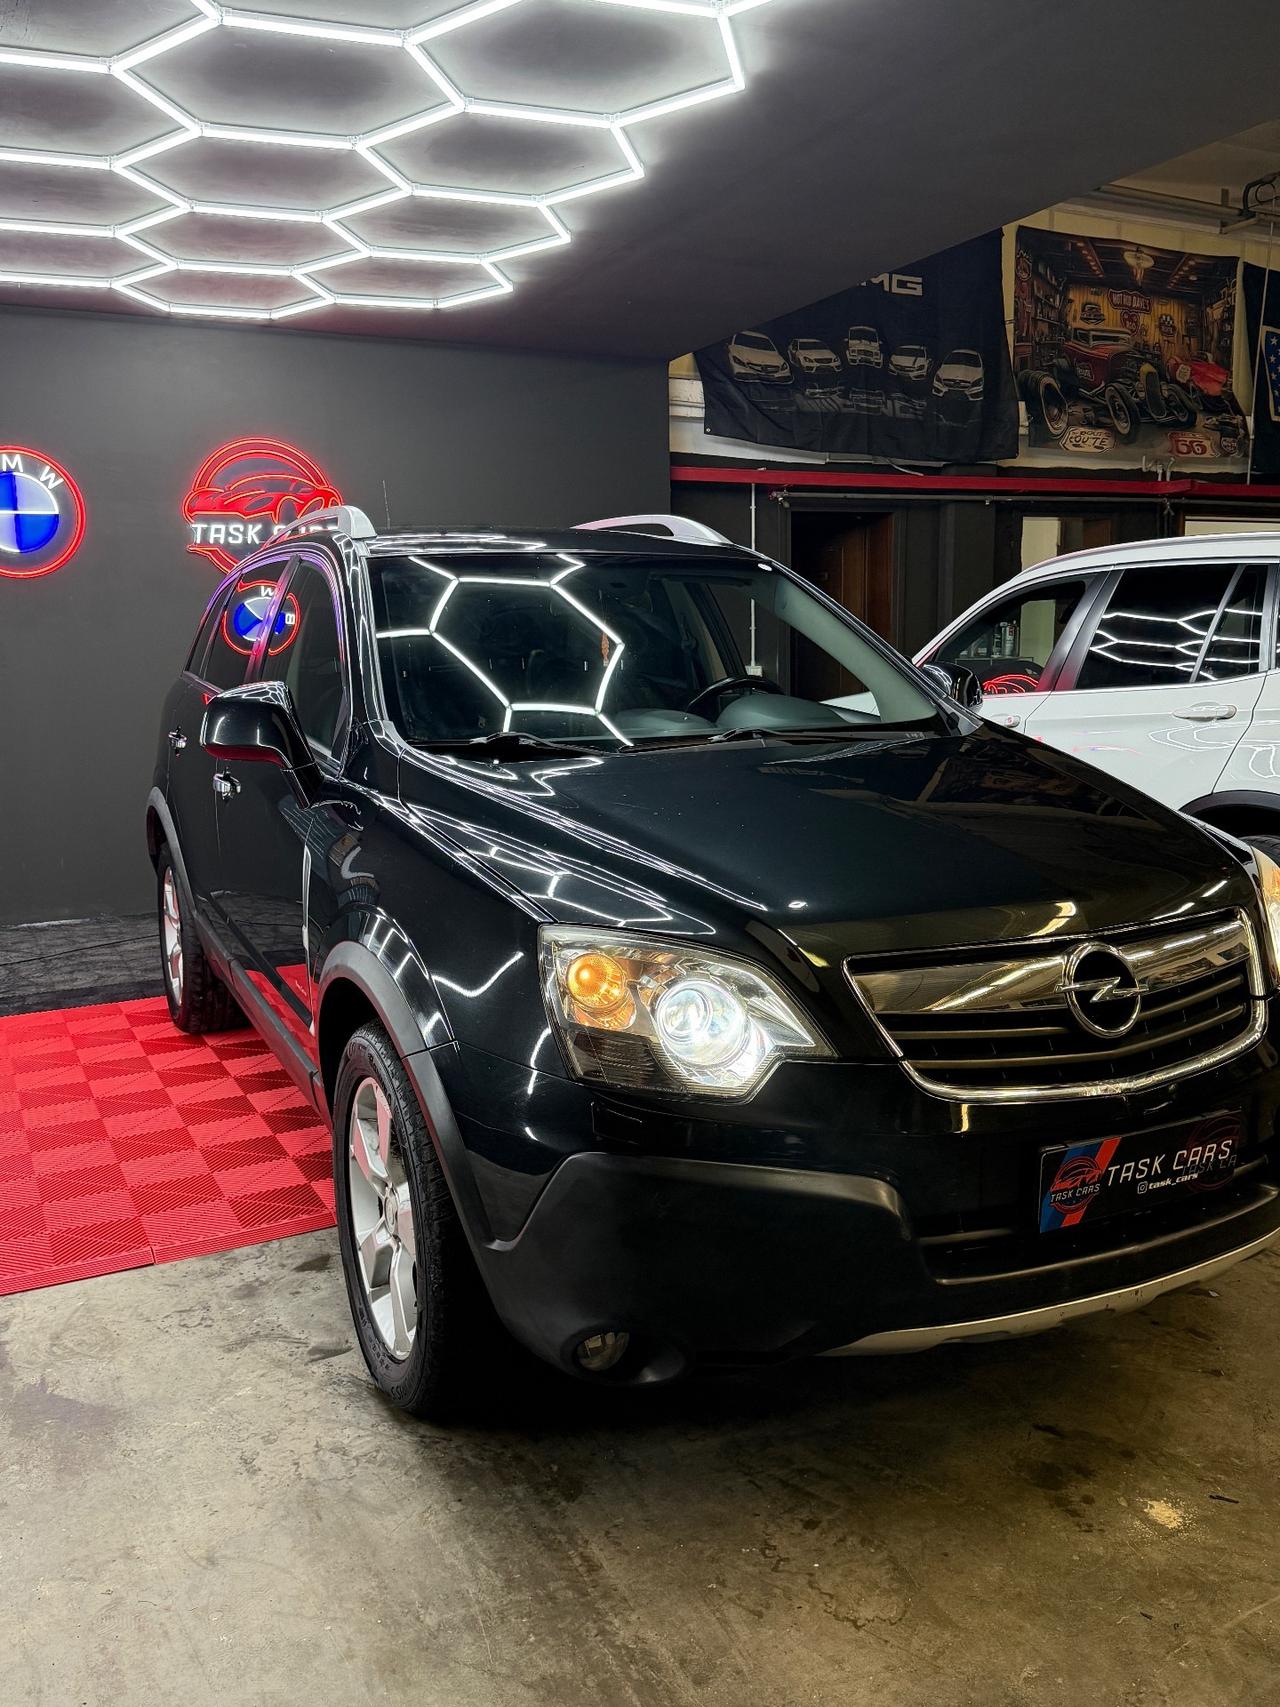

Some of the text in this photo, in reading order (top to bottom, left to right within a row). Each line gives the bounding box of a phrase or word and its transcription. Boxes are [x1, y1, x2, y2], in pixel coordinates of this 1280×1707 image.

[860, 272, 923, 296] MG
[1, 453, 65, 490] MW
[192, 524, 262, 545] TASK
[1107, 1140, 1232, 1187] TASK CARS
[1149, 1172, 1199, 1190] task_cars
[1050, 1183, 1101, 1203] TASK CARS
